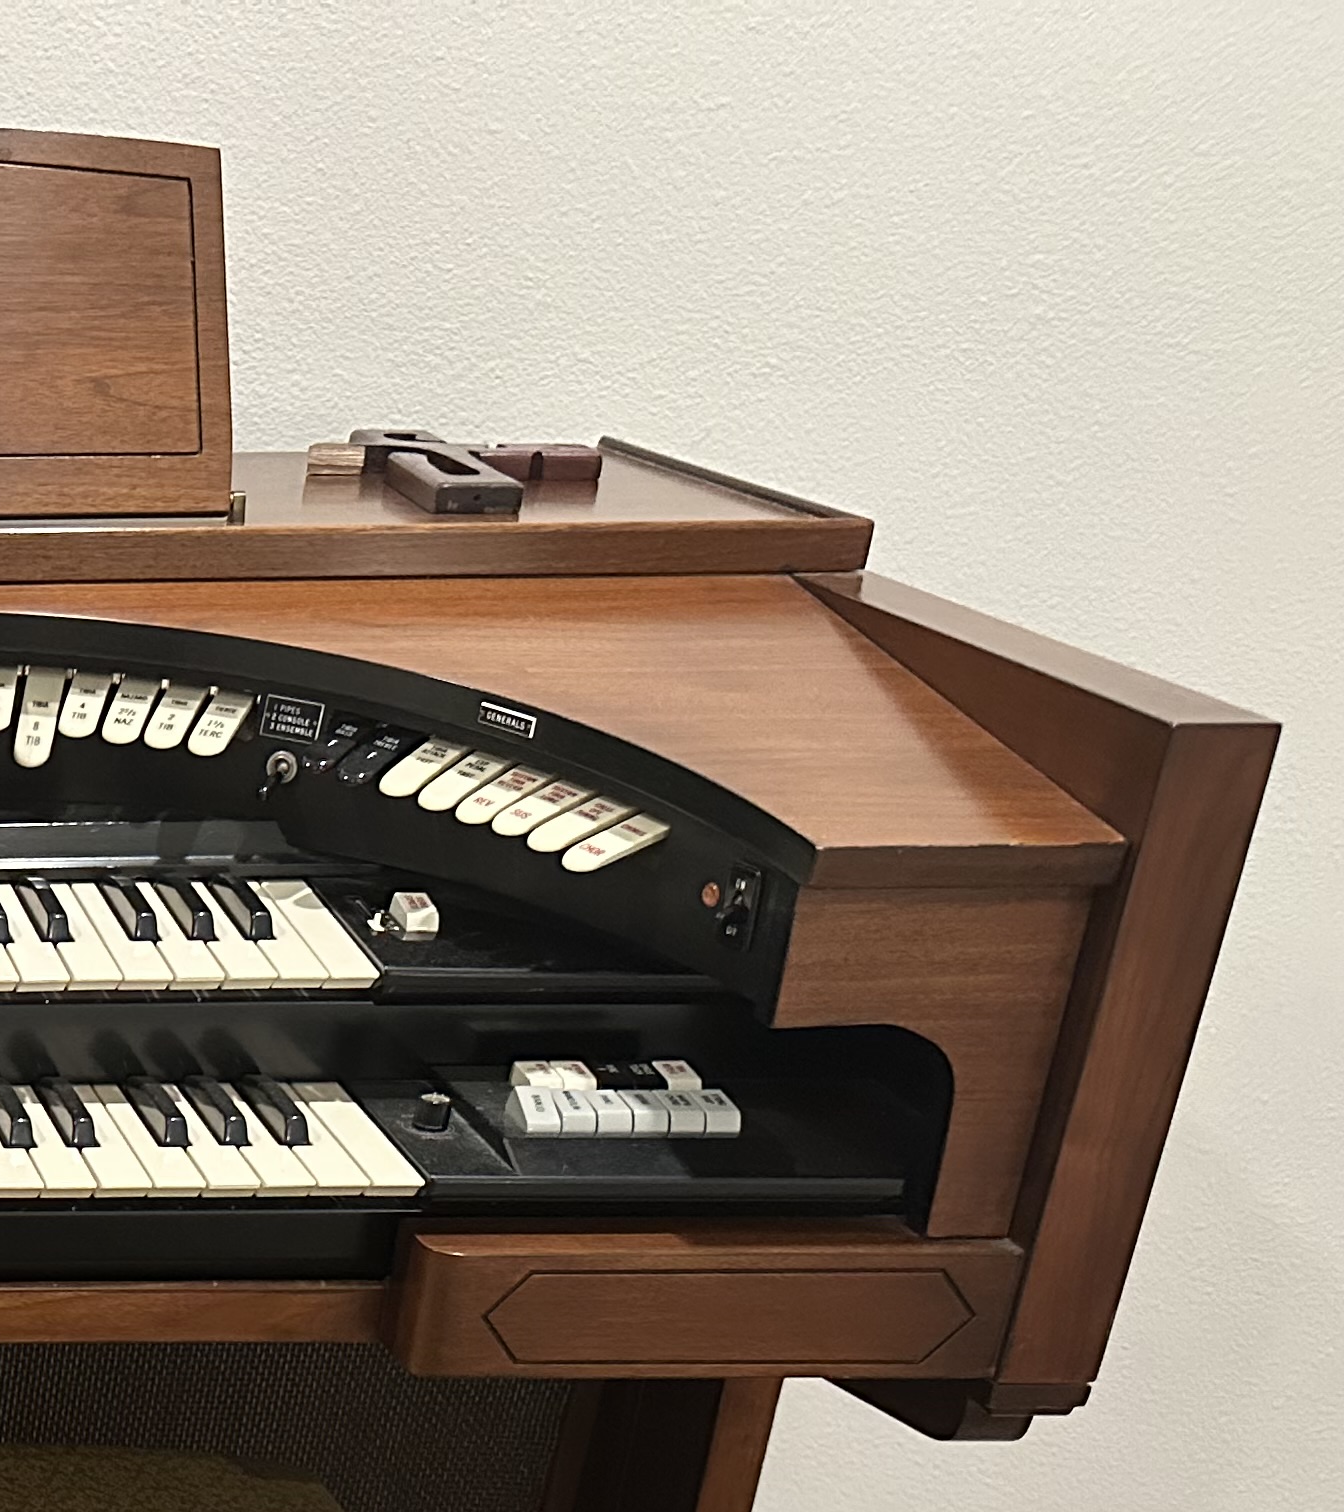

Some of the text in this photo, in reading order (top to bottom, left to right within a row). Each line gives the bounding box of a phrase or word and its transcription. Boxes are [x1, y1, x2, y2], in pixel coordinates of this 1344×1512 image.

[280, 704, 300, 715] PIPES
[72, 712, 87, 720] TIB
[278, 714, 311, 727] CONSOLE
[486, 711, 525, 731] GENERALS
[32, 721, 39, 731] 8
[158, 722, 173, 730] TIB
[276, 723, 314, 737] ENSEMBLE
[198, 729, 223, 738] TERC
[26, 735, 41, 746] TIB
[473, 797, 495, 807] REV
